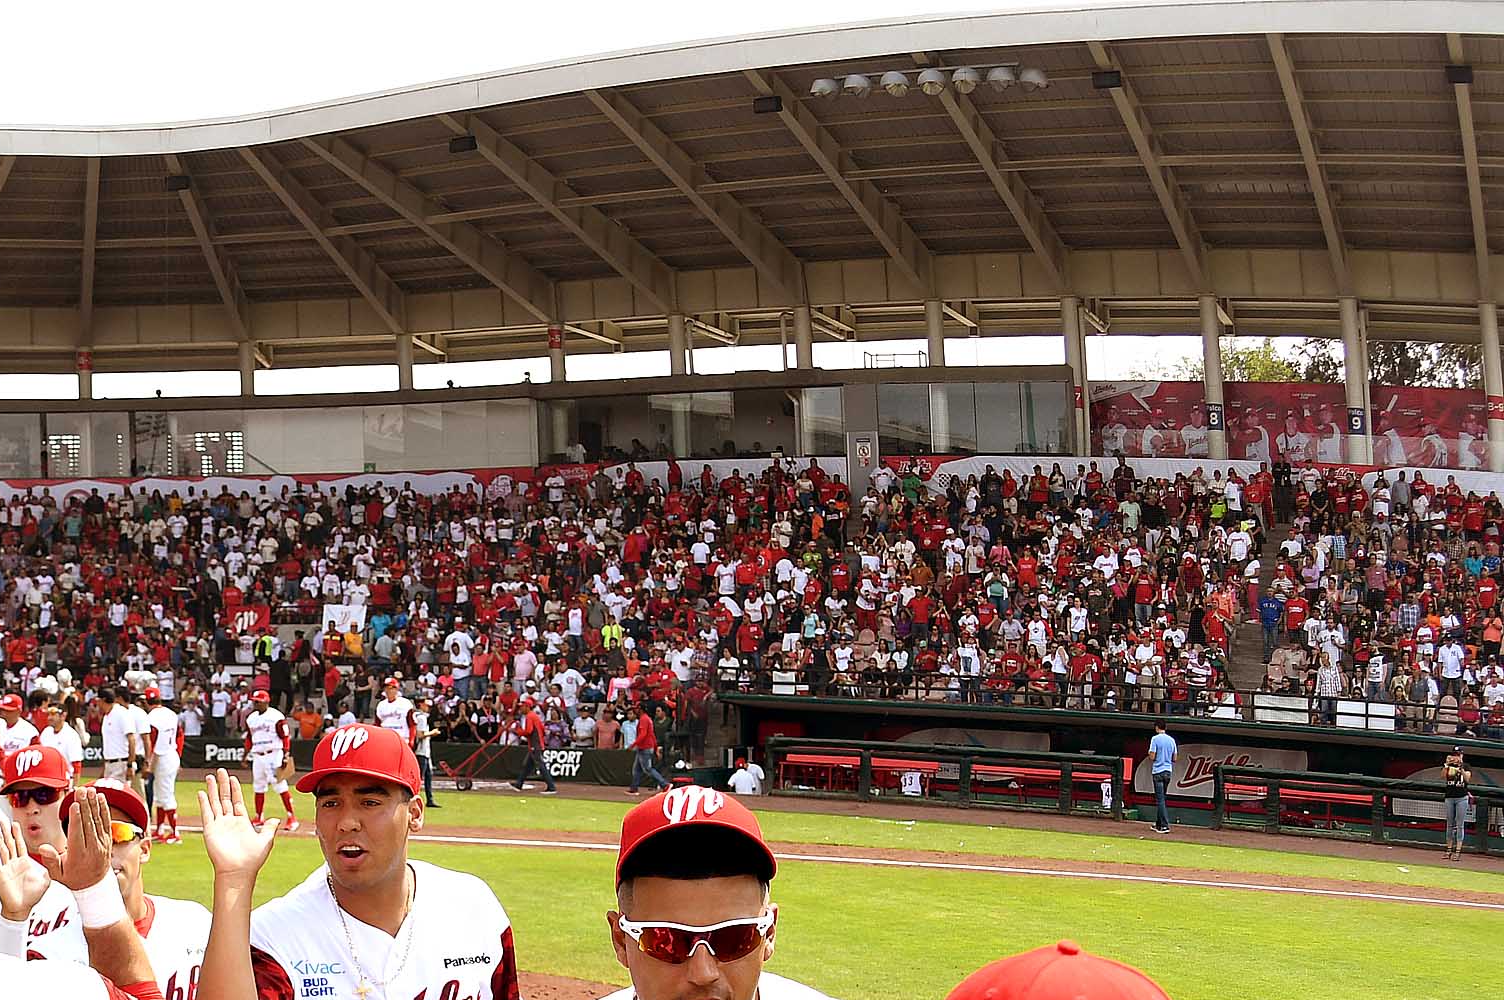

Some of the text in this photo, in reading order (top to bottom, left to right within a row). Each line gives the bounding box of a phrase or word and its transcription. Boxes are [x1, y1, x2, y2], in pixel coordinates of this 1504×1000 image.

[1209, 412, 1218, 425] 8
[1351, 416, 1361, 429] 9
[543, 750, 583, 764] SPORT
[550, 763, 581, 777] CITY
[303, 978, 328, 988] BUD
[301, 987, 335, 998] LIGHT
